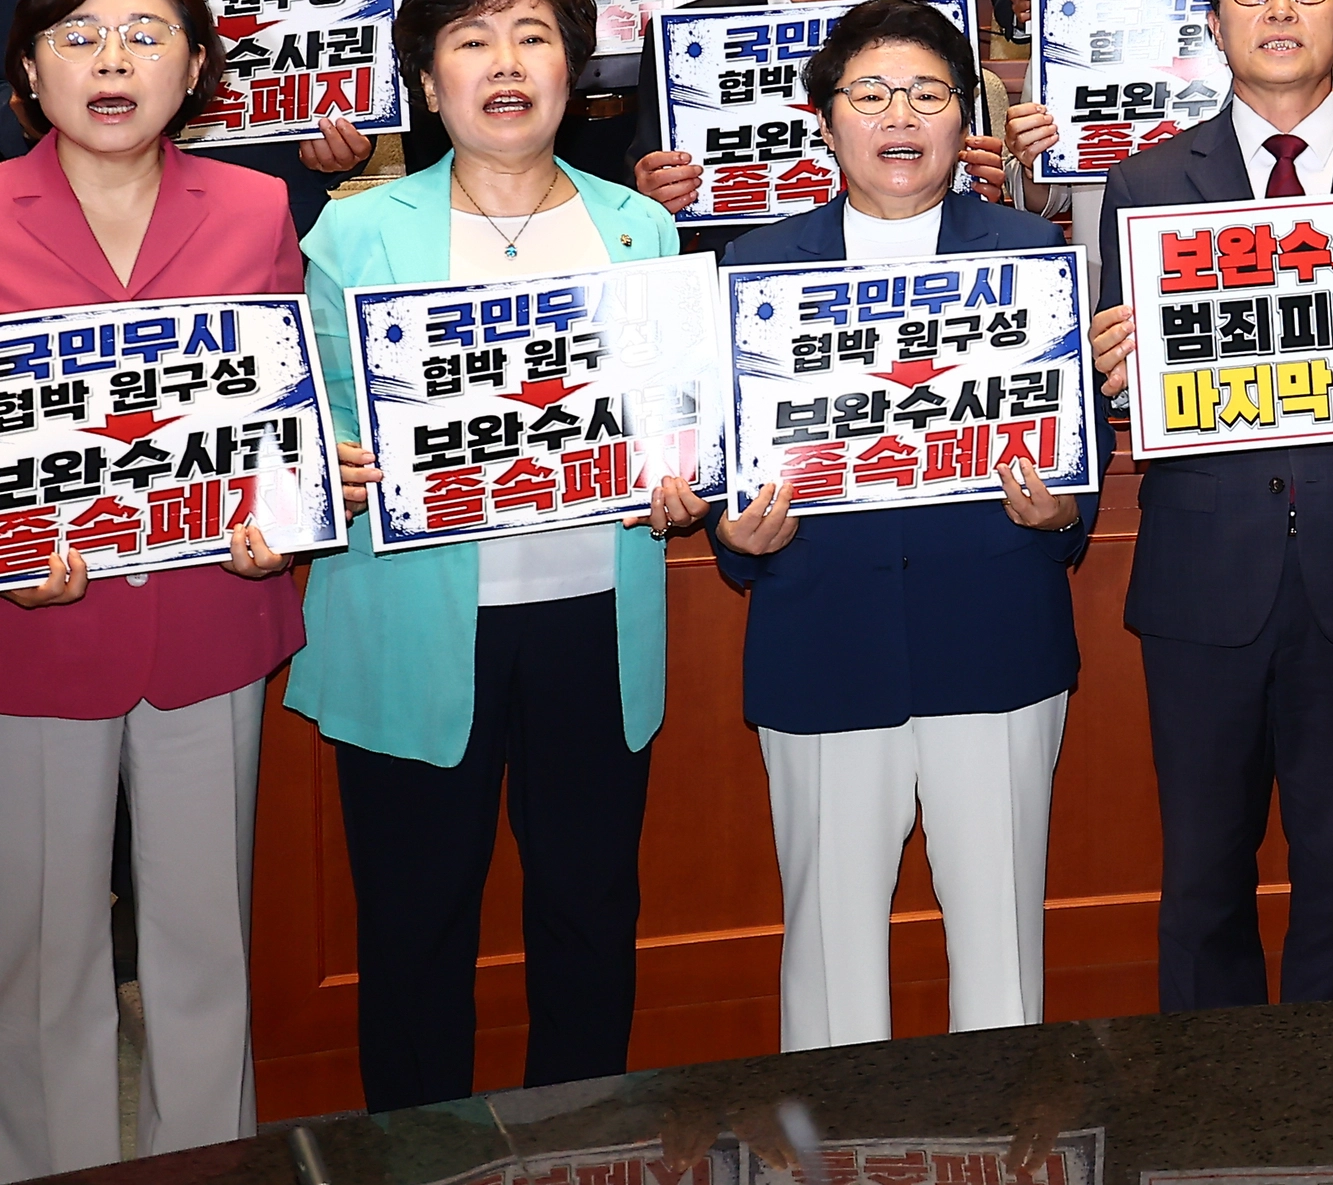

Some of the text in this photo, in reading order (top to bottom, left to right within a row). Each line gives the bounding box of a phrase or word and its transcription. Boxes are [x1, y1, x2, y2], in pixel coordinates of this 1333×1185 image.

[724, 16, 842, 62] 국민
[718, 63, 797, 105] 협박
[711, 159, 848, 213] 졸속
[798, 263, 1015, 326] 국민무시
[0, 309, 239, 381] 국민무시
[422, 347, 507, 398] 협박
[791, 309, 1029, 374] 협박 원구성
[0, 356, 258, 434] 협박 원구성
[772, 369, 1060, 446] 보완수사권
[423, 428, 698, 530] 졸속폐지
[780, 416, 1058, 501] 졸속폐지
